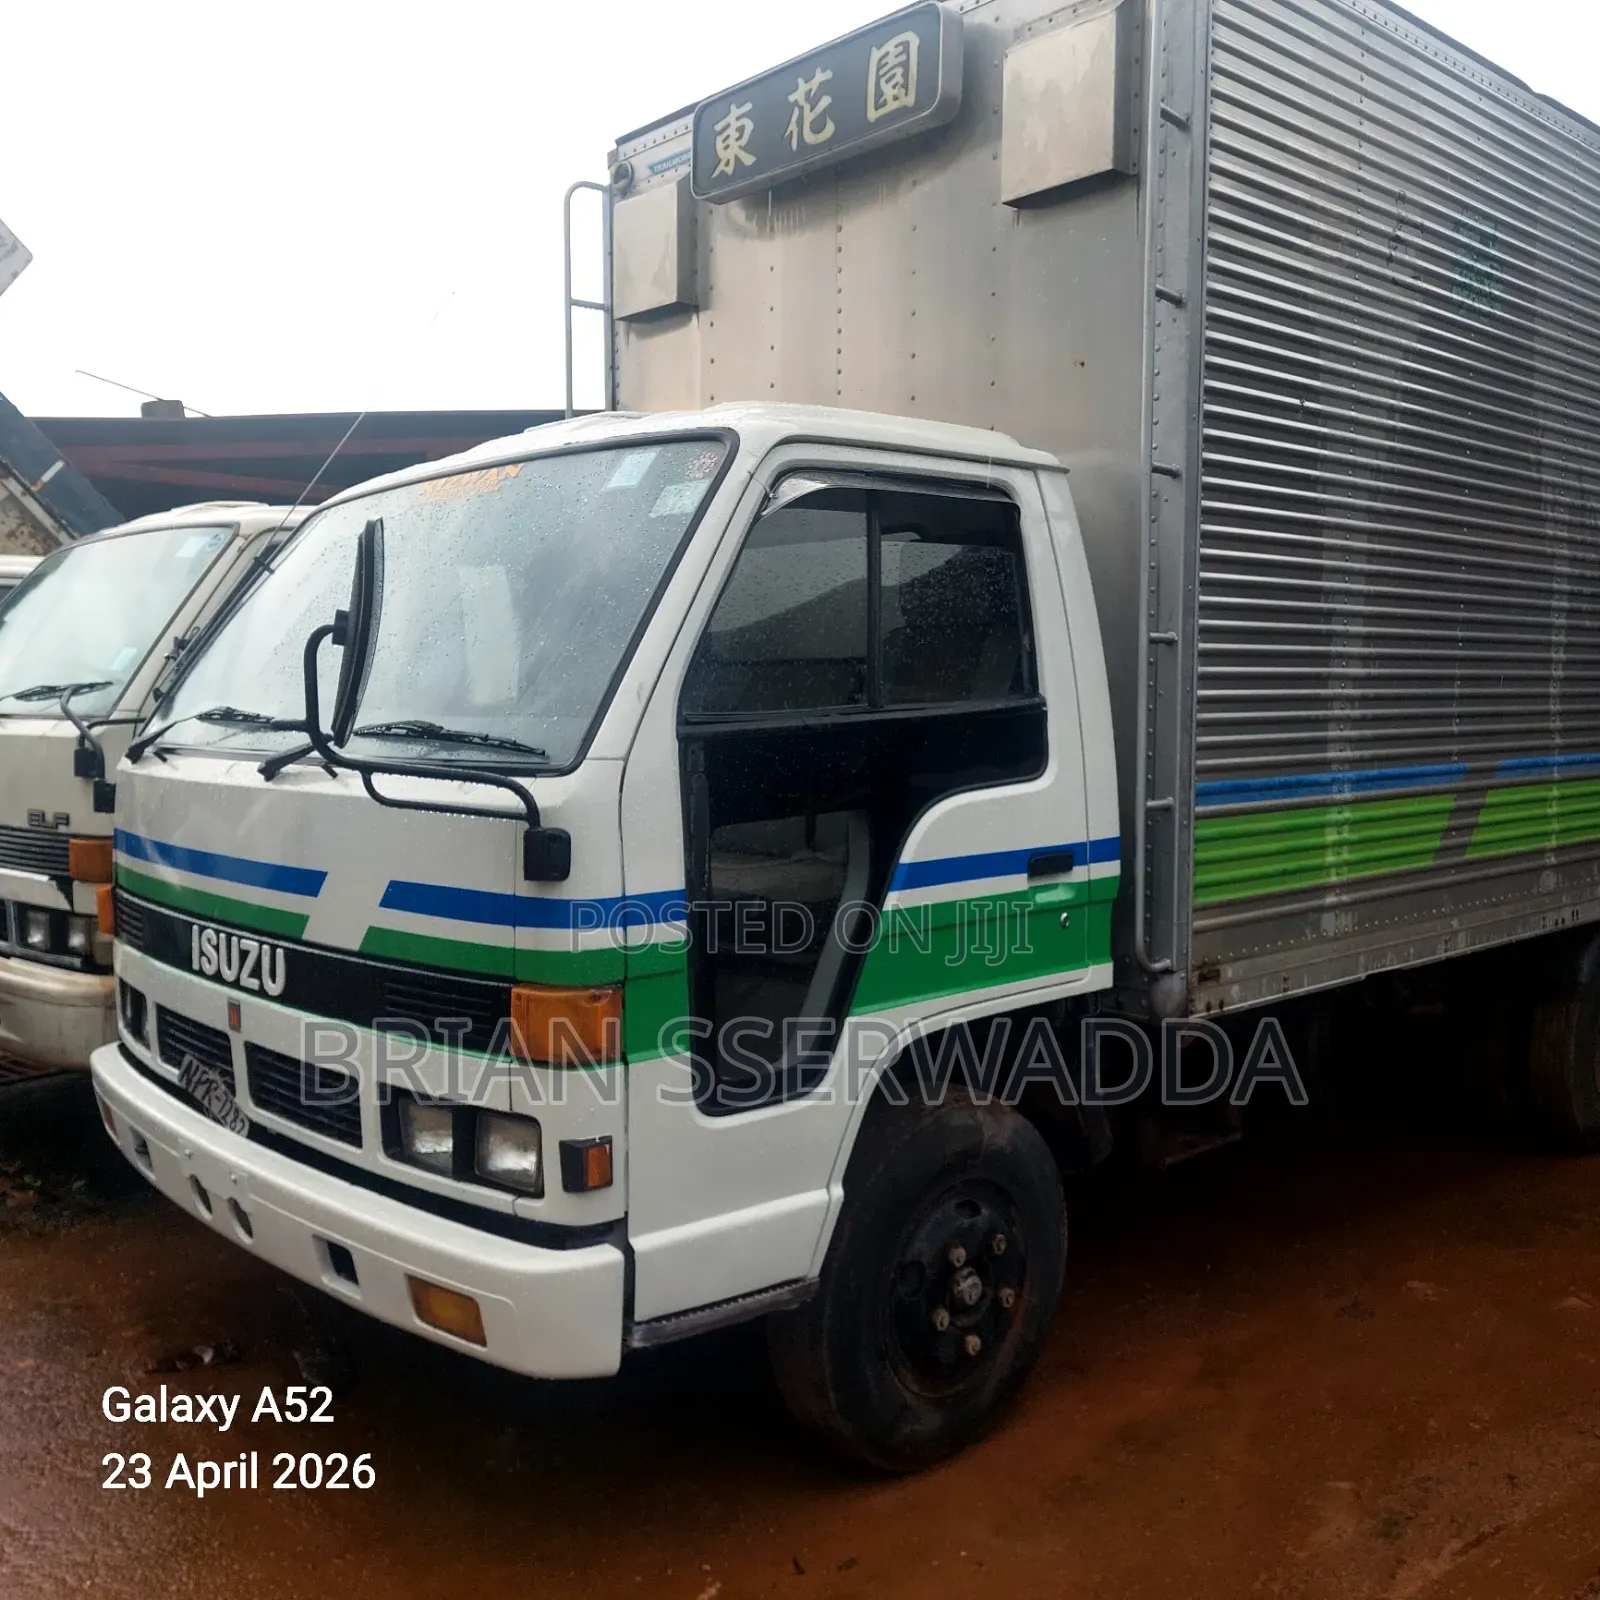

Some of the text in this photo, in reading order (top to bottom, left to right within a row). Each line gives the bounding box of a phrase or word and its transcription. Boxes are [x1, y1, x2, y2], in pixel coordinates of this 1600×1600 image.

[711, 30, 920, 178] 東花園
[27, 808, 70, 830] ELF
[192, 924, 286, 996] ISUZU
